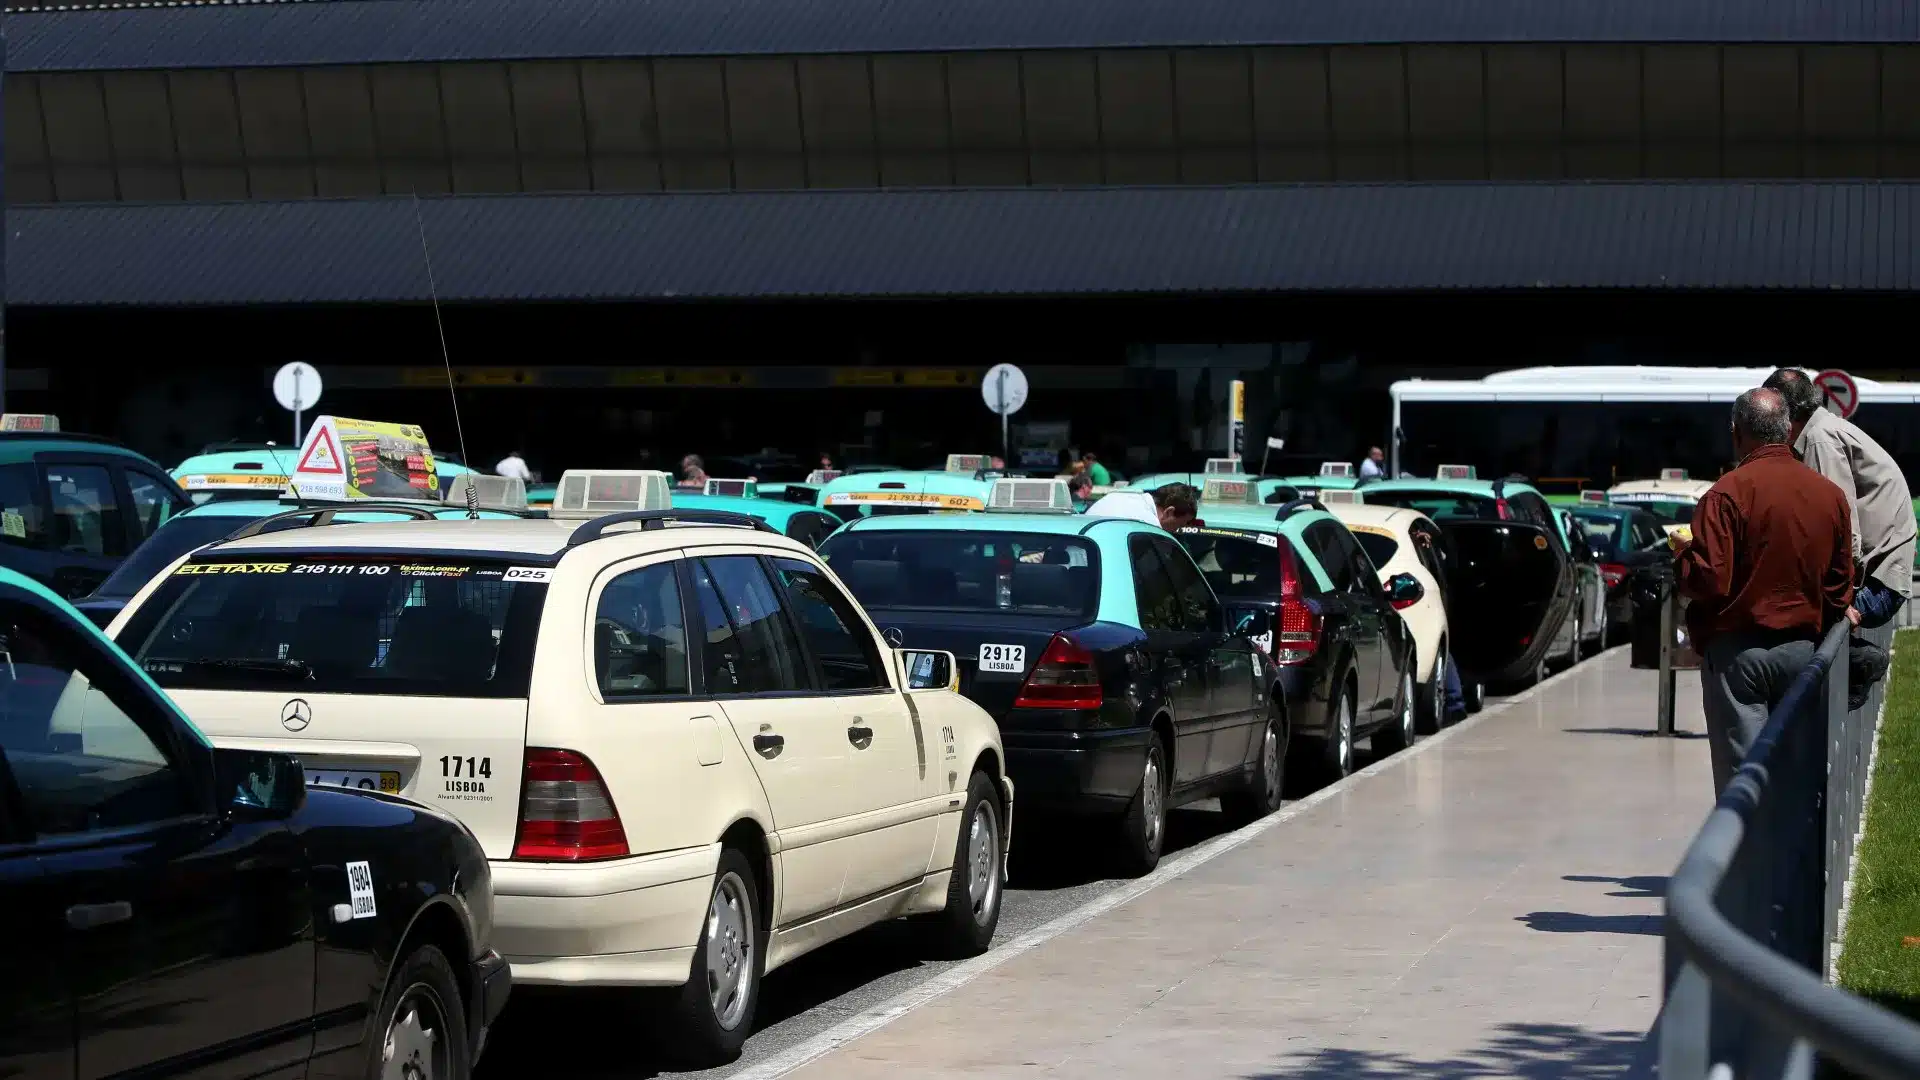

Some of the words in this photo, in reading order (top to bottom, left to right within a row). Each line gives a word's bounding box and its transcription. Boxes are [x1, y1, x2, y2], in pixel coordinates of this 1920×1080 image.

[949, 497, 970, 506] 602
[292, 564, 327, 574] 218
[328, 564, 355, 575] 111
[358, 565, 390, 575] 100
[400, 565, 470, 573] taxinet.com.pt
[507, 569, 547, 579] 025
[983, 645, 1022, 662] 2912
[989, 661, 1015, 671] LISBOA
[439, 755, 492, 778] 1714
[445, 780, 485, 793] LISBOA
[350, 865, 371, 892] 1984
[353, 896, 374, 914] LISBOA
